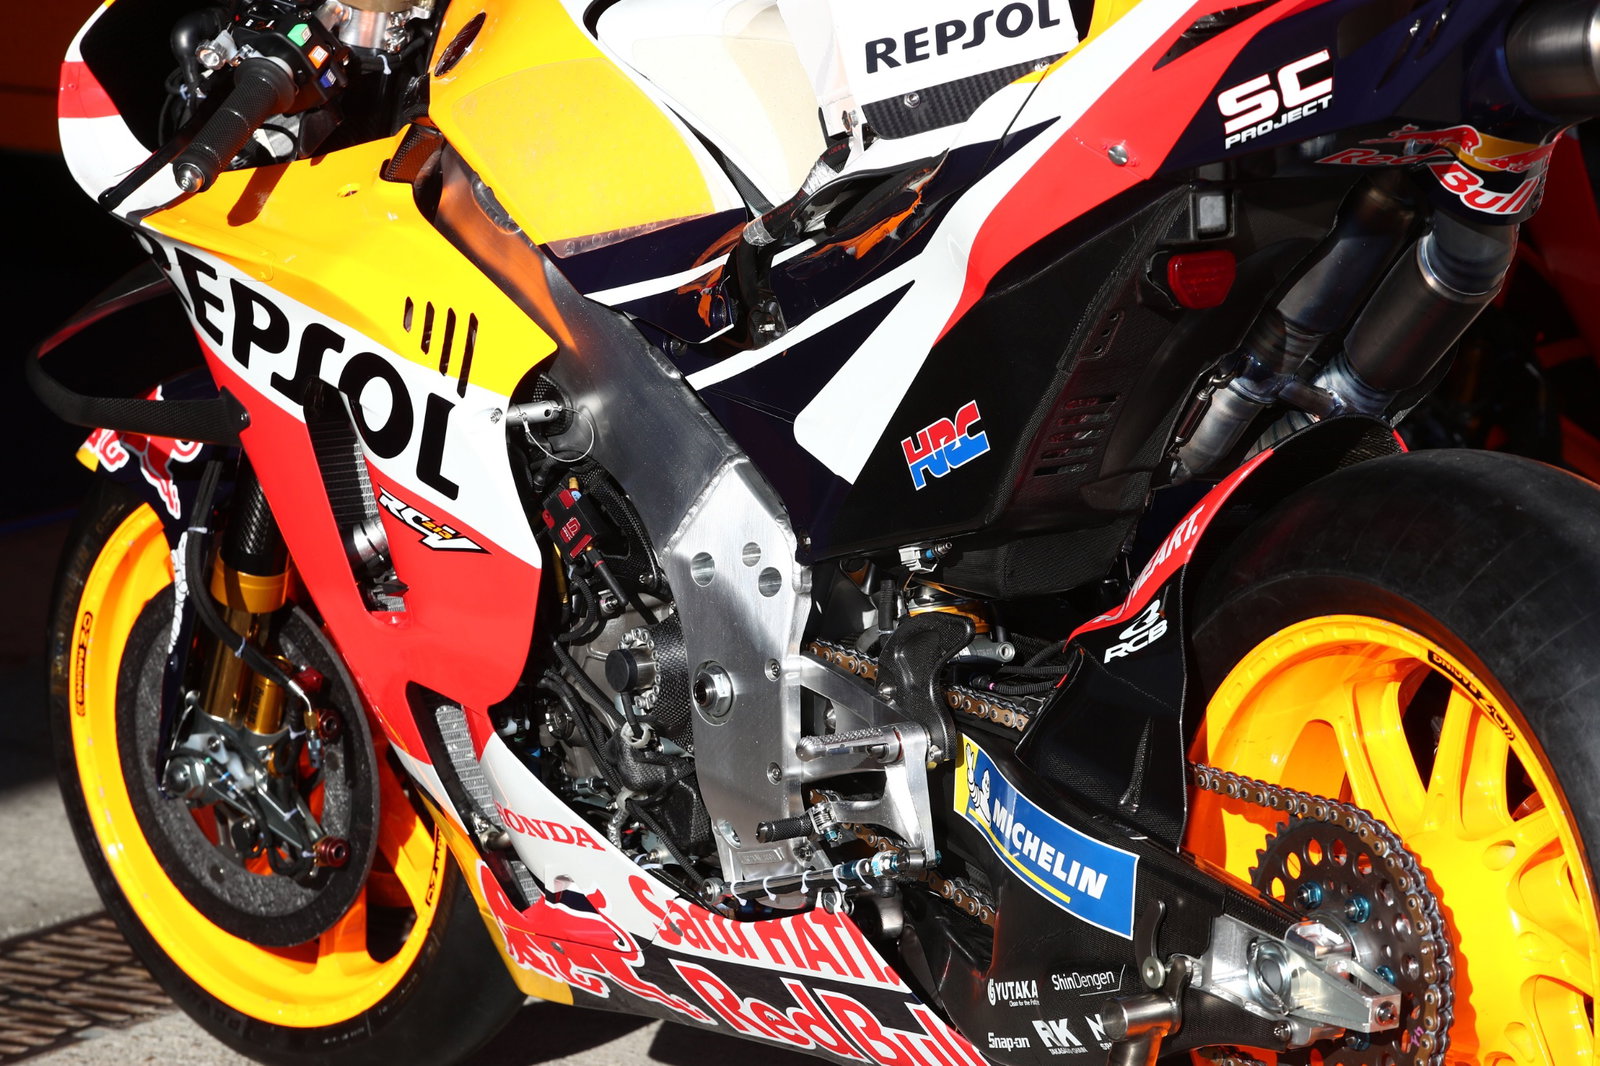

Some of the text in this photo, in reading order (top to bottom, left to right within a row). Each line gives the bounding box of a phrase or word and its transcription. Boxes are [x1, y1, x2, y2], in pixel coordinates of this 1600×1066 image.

[865, 0, 1060, 74] REPSOL
[1217, 48, 1333, 135] SC
[1225, 94, 1333, 150] PROJECT
[1316, 147, 1542, 215] Red Bull
[900, 399, 991, 491] HRC
[1103, 620, 1168, 664] RCB
[1432, 652, 1478, 694] RACING
[992, 797, 1109, 901] MICHELIN
[628, 874, 760, 960] Satu
[994, 980, 1038, 1001] YUTAKA
[1051, 971, 1115, 991] ShinDengen
[674, 964, 868, 1061] Red
[987, 1032, 1031, 1052] Snap-on
[1032, 1018, 1083, 1047] RK
